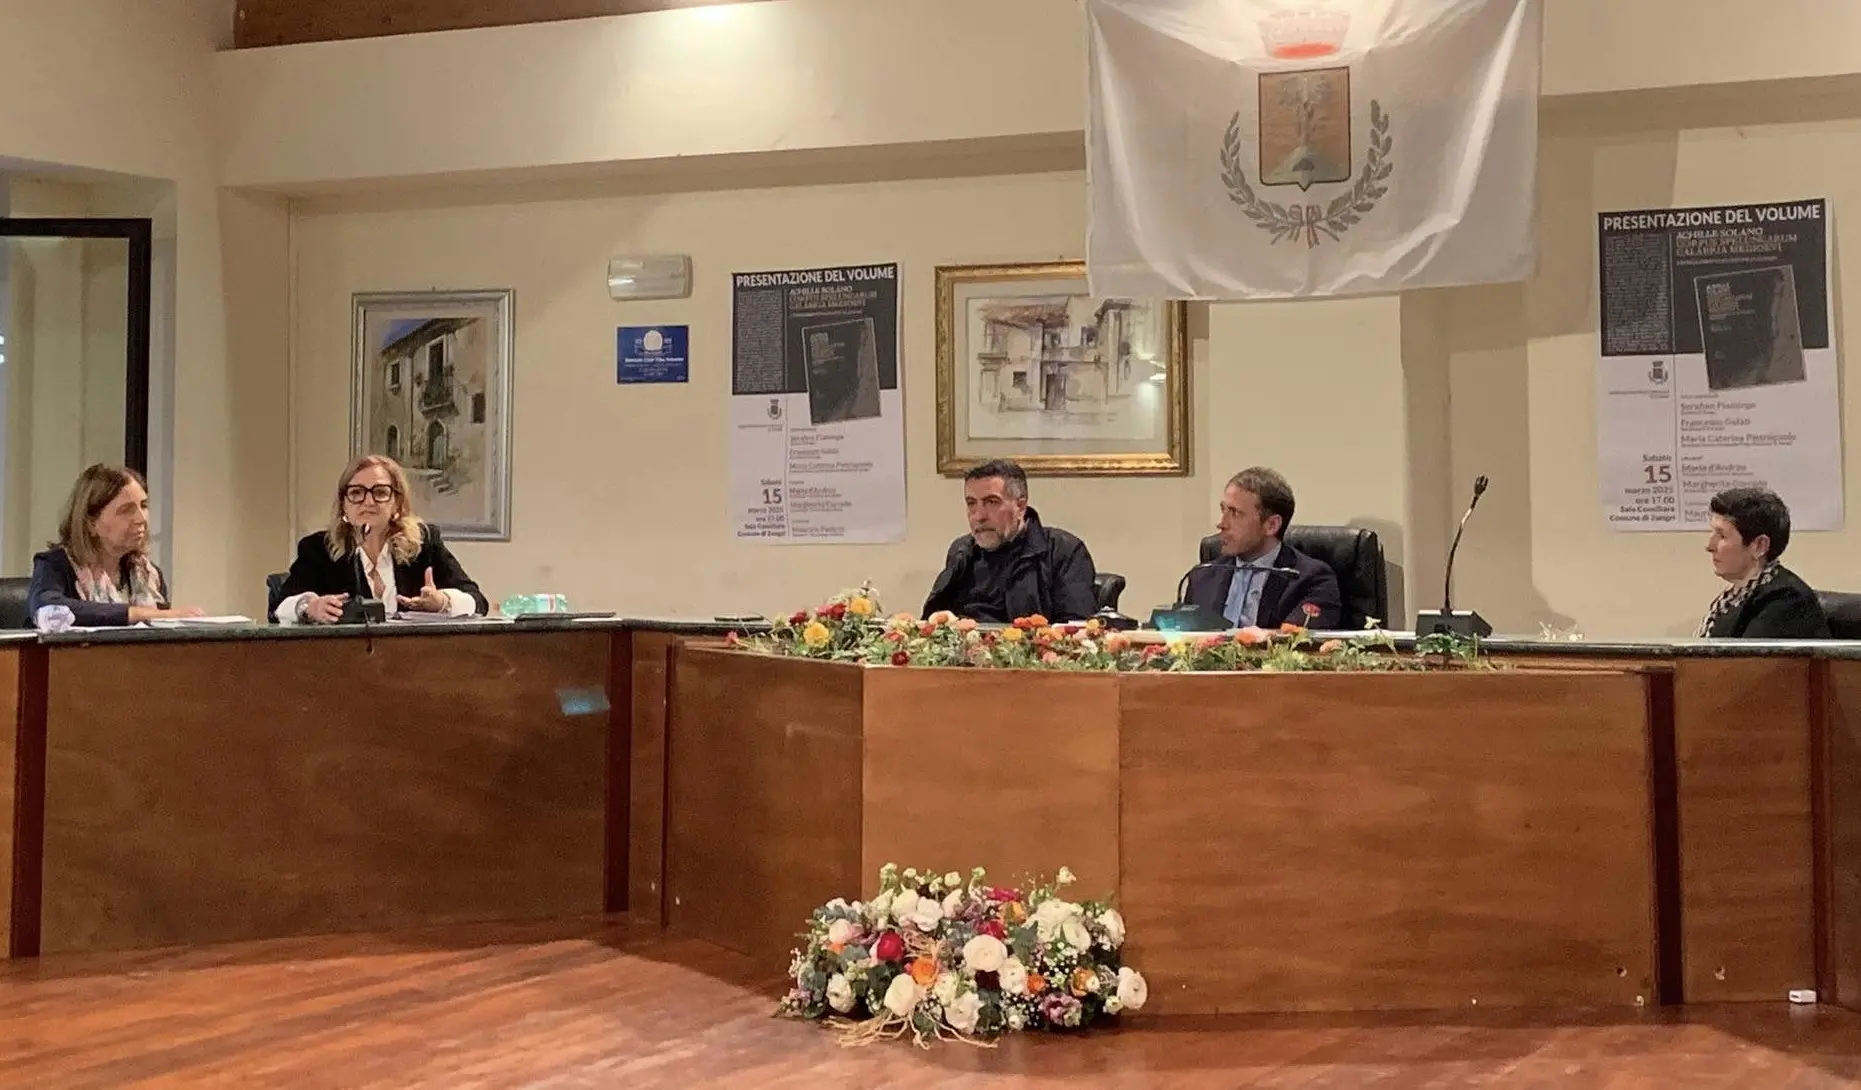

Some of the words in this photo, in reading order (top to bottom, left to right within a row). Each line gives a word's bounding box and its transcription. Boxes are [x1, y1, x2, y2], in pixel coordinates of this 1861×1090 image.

[1604, 210, 1721, 230] PRESENTAZIONE
[1726, 210, 1752, 223] DEL
[1756, 205, 1820, 221] VOLUME
[1720, 228, 1763, 237] SOLANO
[736, 272, 822, 287] PRESENTAZIONE
[825, 270, 845, 282] DEL
[848, 267, 894, 280] VOLUME
[1644, 465, 1672, 484] 15
[762, 488, 782, 504] 15
